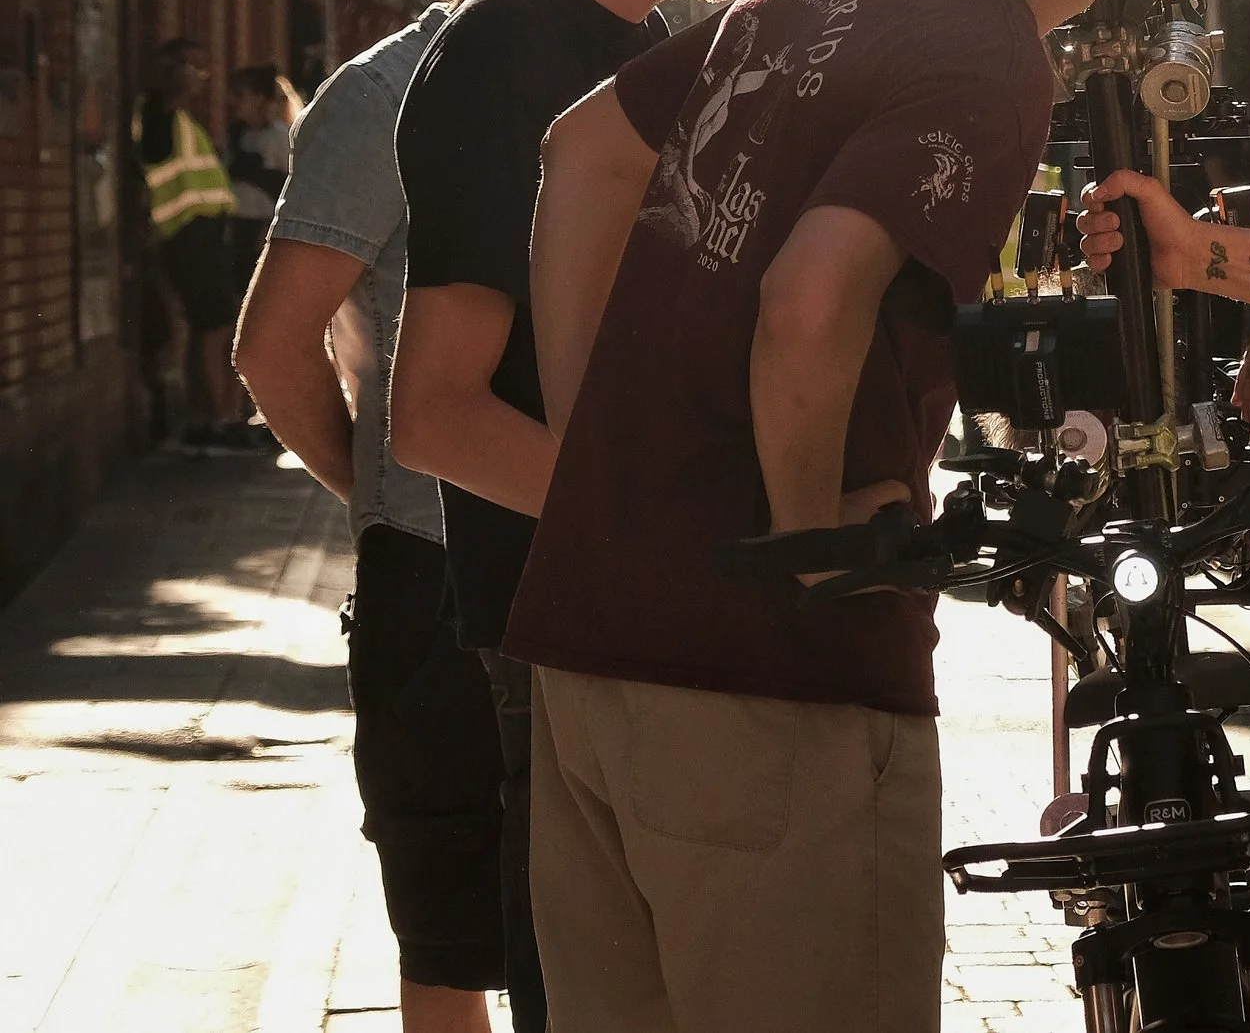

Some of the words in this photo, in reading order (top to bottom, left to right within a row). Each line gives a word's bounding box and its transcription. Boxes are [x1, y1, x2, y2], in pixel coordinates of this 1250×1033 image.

[961, 155, 974, 203] GRIPS
[696, 253, 719, 272] 2020
[1035, 361, 1051, 421] PRODUCTIONS
[1149, 806, 1186, 822] R&M
